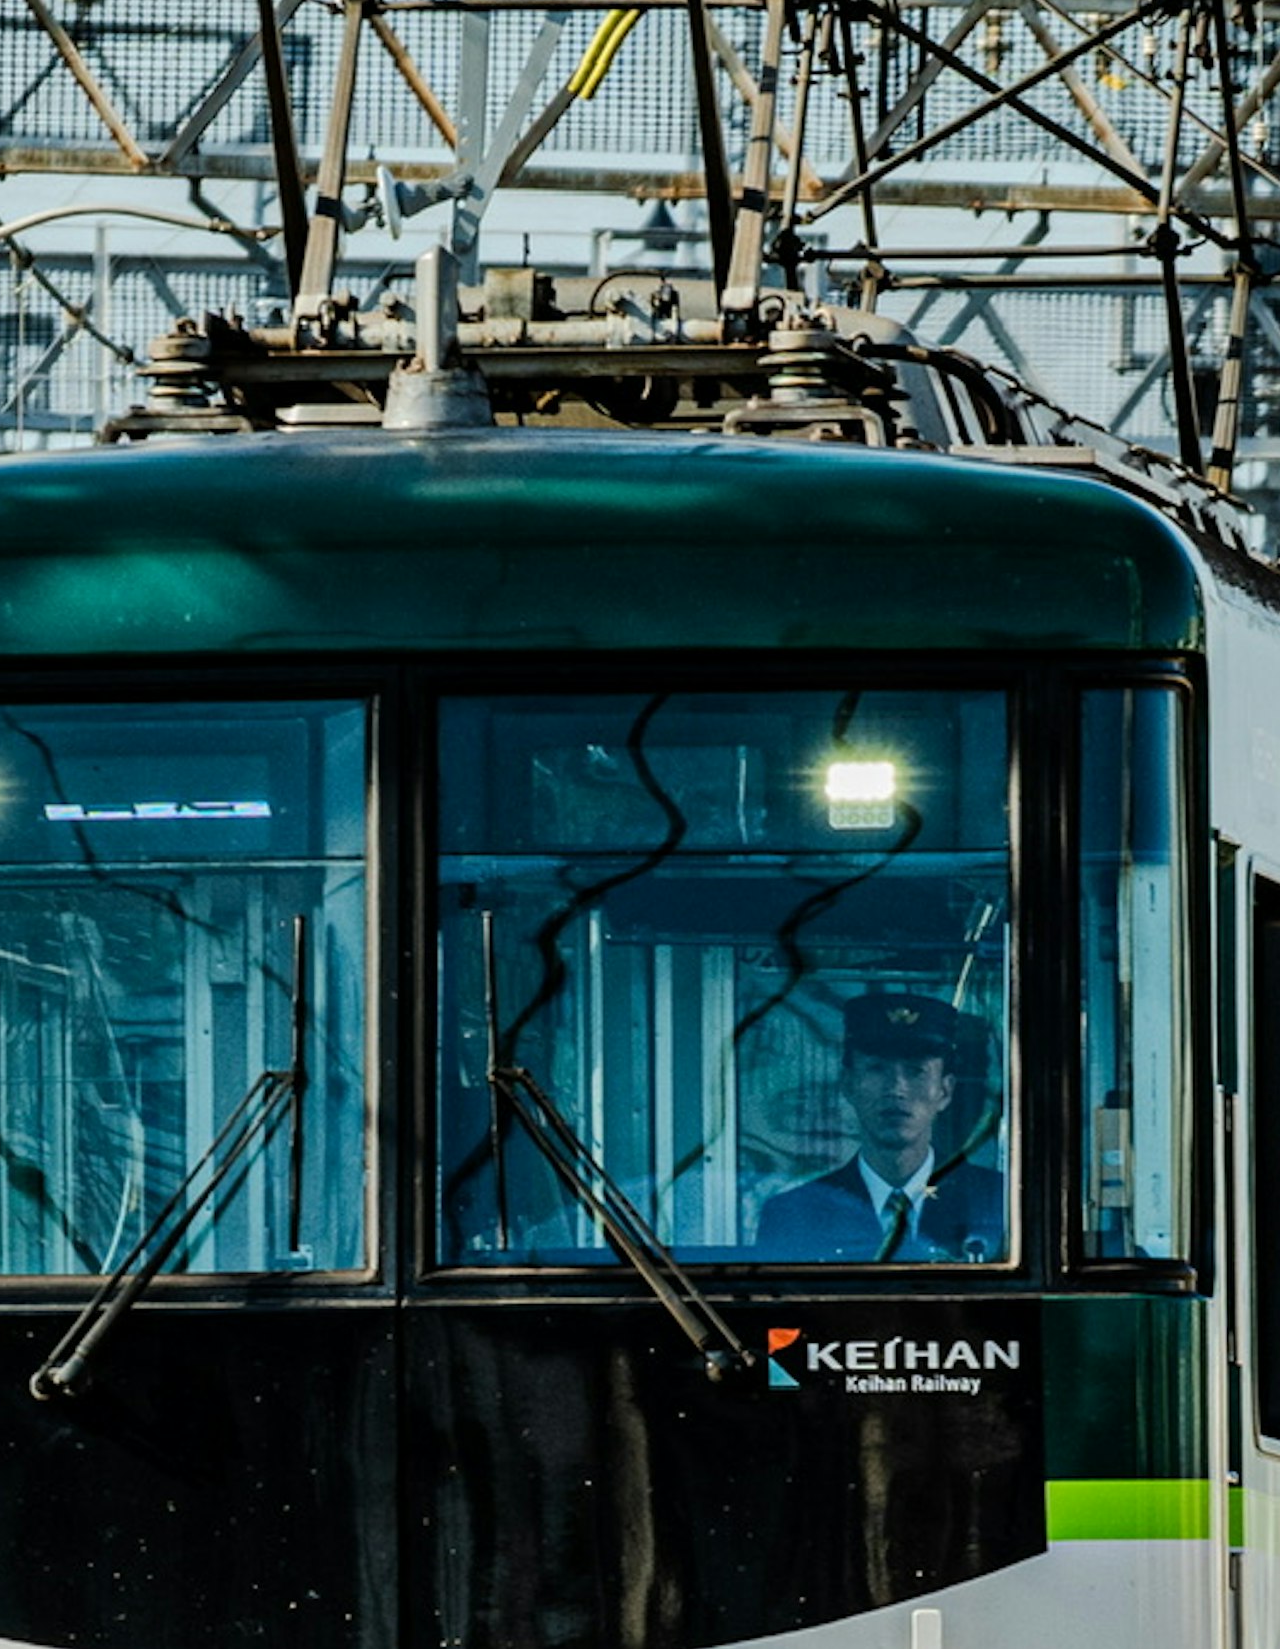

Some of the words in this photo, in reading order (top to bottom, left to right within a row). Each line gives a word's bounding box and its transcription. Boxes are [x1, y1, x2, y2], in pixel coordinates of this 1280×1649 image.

[806, 1336, 1020, 1370] KEIHAN
[845, 1375, 907, 1393] Keihan
[910, 1374, 981, 1396] Railway
